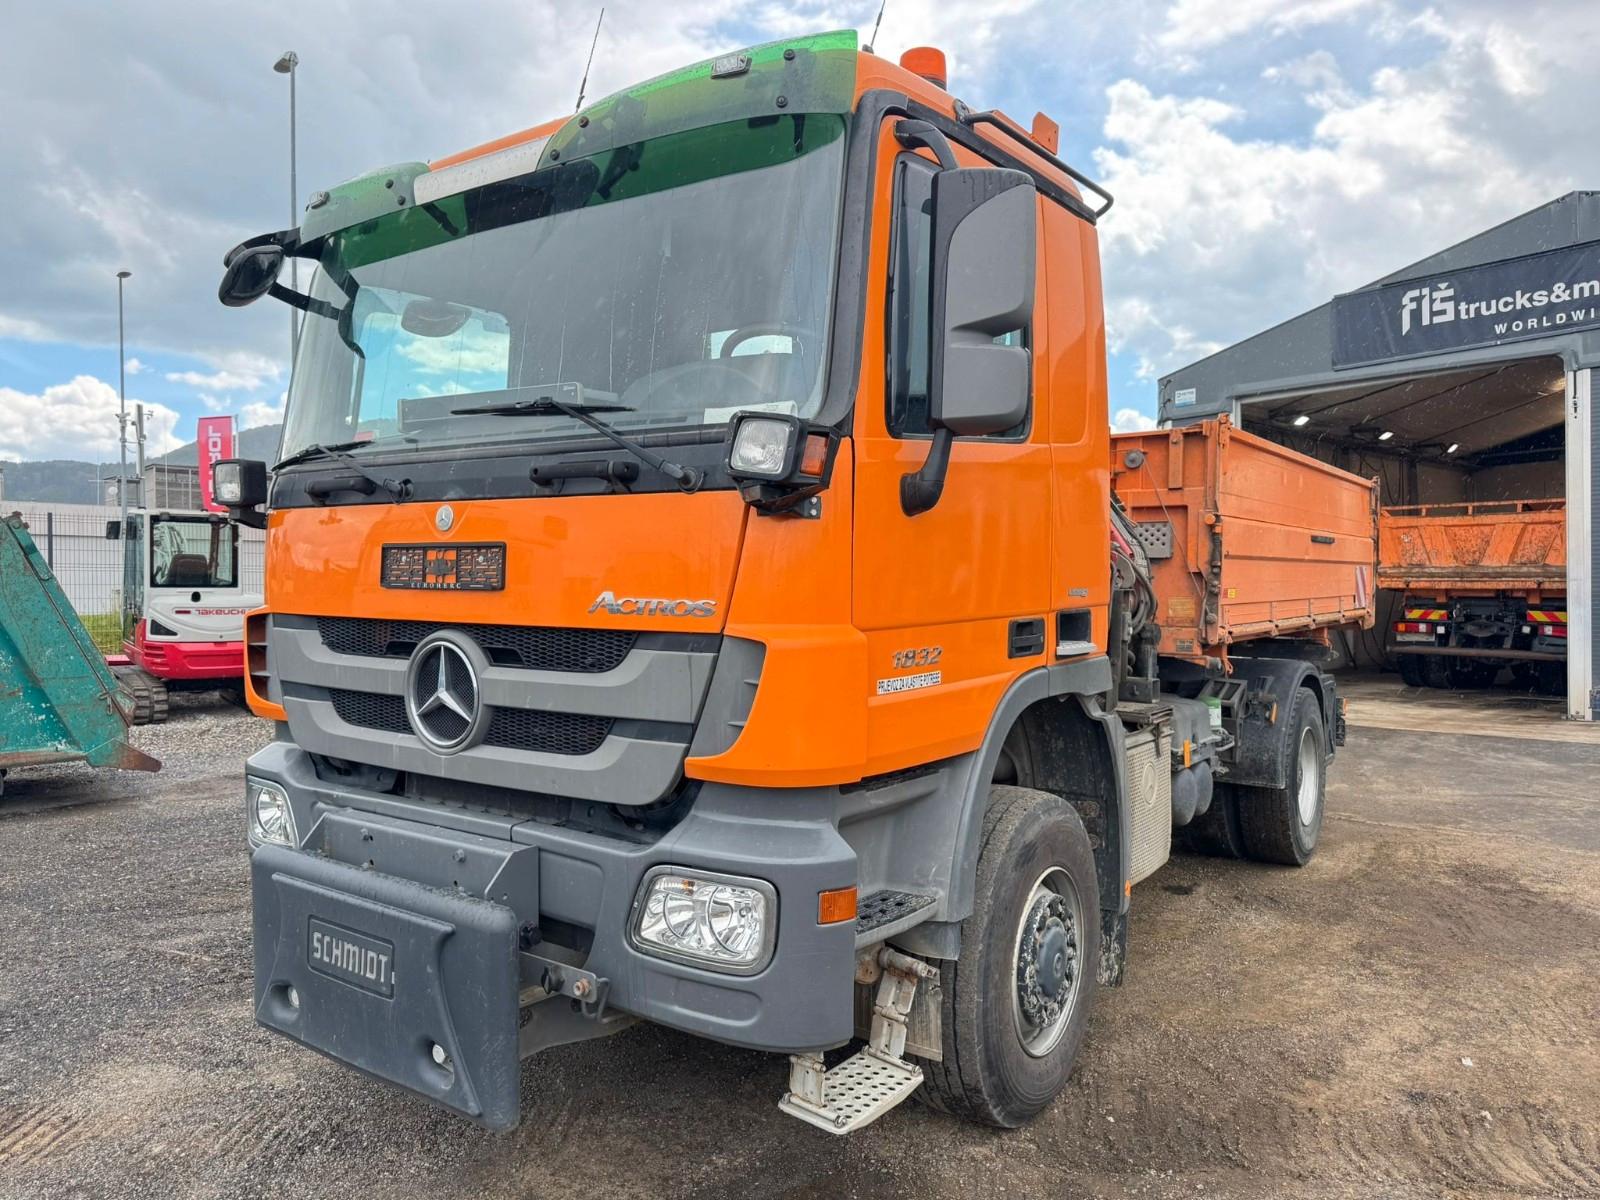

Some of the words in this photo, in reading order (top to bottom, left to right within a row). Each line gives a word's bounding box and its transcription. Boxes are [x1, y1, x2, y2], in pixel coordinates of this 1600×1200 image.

[1495, 308, 1595, 334] WORLDWI
[892, 647, 942, 669] 1832
[313, 932, 388, 983] SCHMIDT
